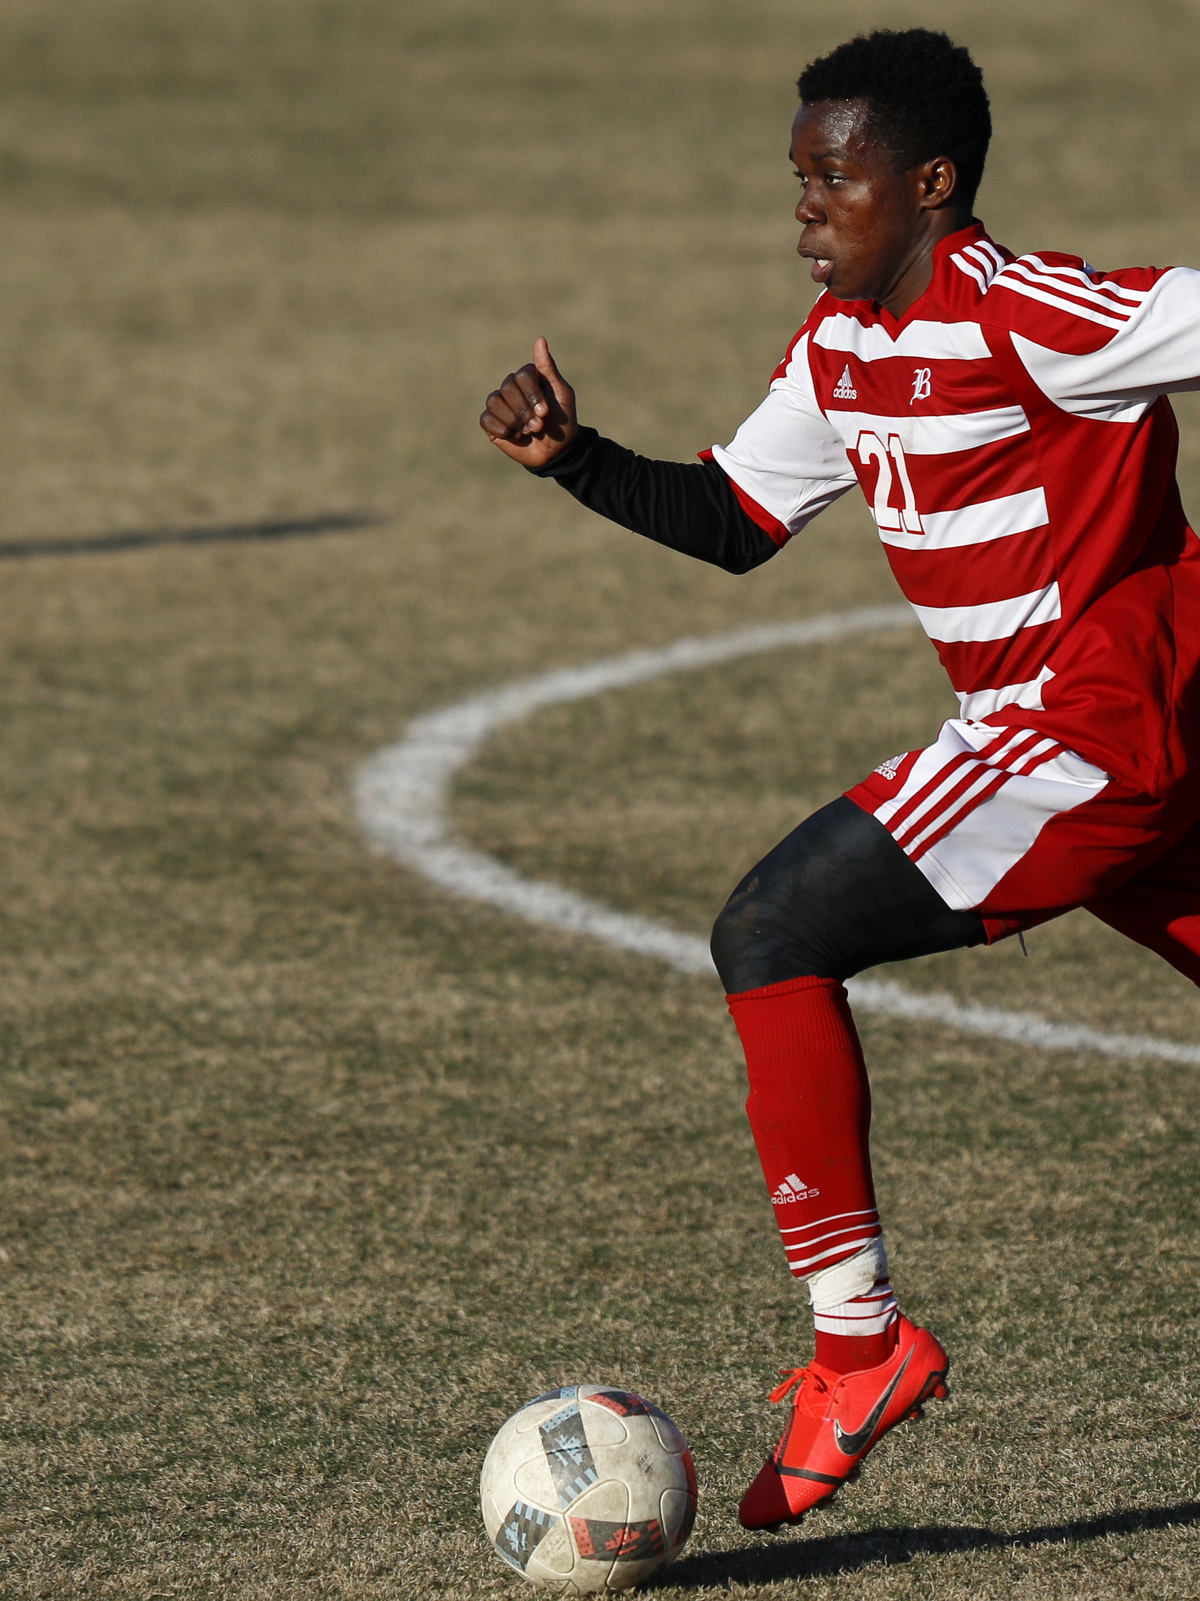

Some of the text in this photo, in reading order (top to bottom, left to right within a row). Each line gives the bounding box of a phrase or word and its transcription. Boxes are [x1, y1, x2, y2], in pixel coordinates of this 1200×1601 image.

[833, 386, 858, 400] adidas
[856, 430, 926, 535] 21
[771, 1188, 820, 1205] adidas
